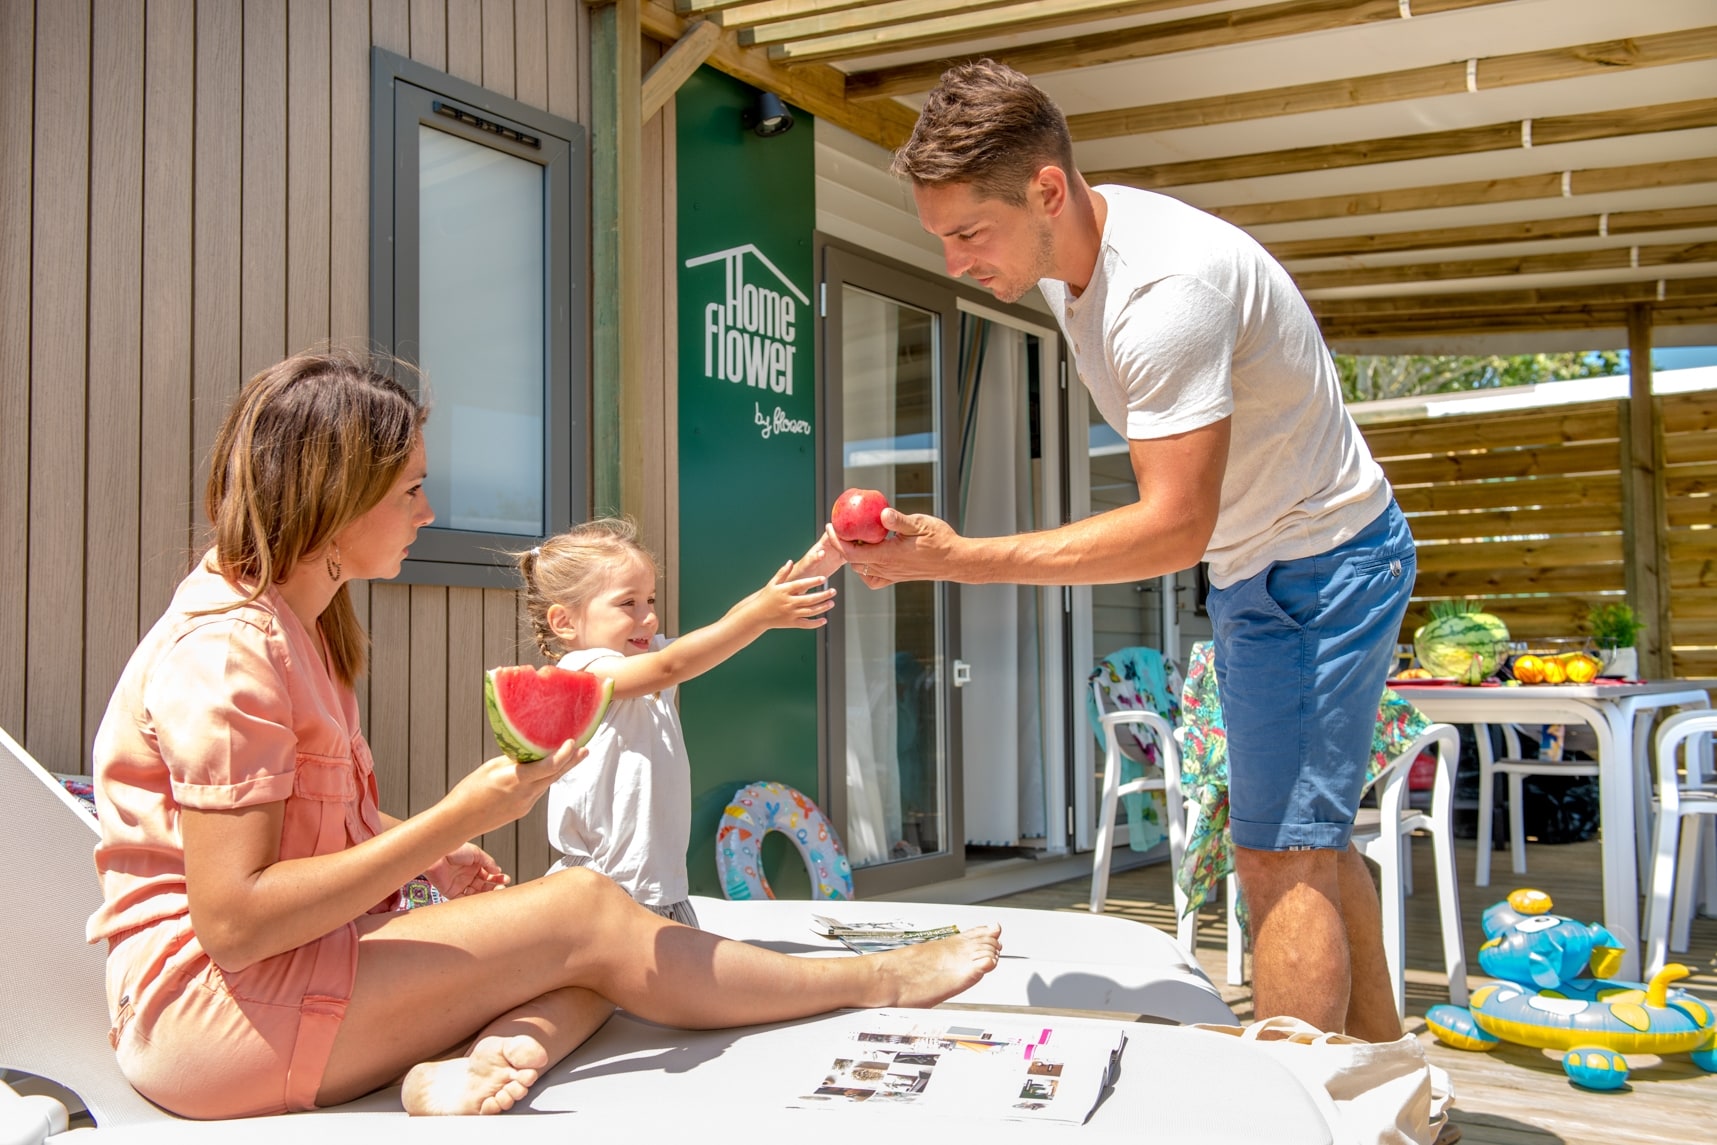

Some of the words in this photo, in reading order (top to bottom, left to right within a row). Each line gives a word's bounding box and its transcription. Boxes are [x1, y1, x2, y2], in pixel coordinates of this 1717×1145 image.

[726, 253, 796, 342] Home
[754, 401, 772, 439] by
[773, 406, 811, 435] flower
